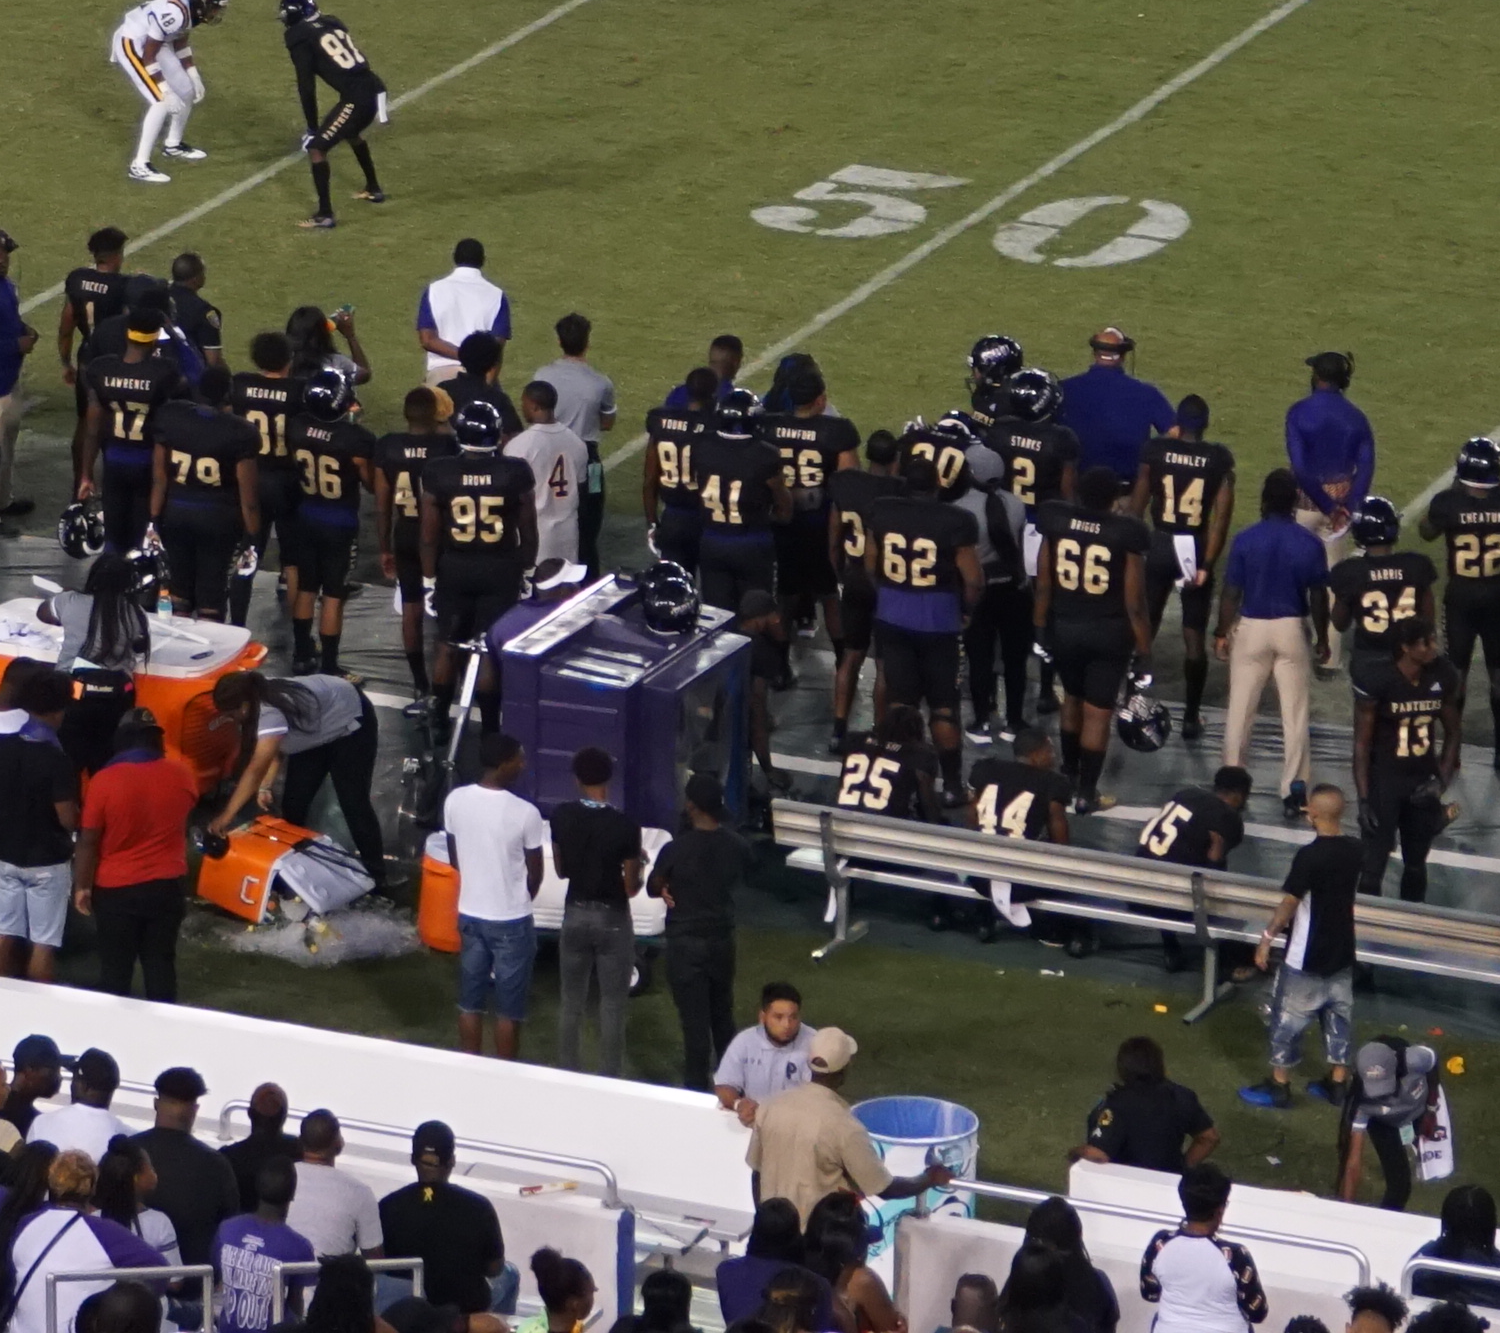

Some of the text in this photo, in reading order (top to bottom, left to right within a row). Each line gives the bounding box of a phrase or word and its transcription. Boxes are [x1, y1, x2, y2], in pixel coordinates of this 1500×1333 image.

[160, 12, 176, 30] 48
[322, 102, 355, 142] PANTHERS
[750, 163, 1192, 268] 50
[104, 375, 152, 392] LAWRENCE
[112, 400, 150, 442] 17
[661, 419, 688, 432] YOUNG
[776, 427, 817, 442] CRAWFORD
[1010, 434, 1042, 452] STARKS
[295, 450, 343, 501] 36
[404, 446, 427, 459] WADE
[462, 473, 493, 487] BROWN
[547, 453, 569, 499] 4
[1012, 456, 1036, 505] 2
[450, 496, 505, 543] 95
[701, 474, 743, 525] 41
[1162, 474, 1205, 527] 14
[883, 532, 938, 587] 62
[1055, 538, 1111, 595] 66
[1360, 586, 1417, 634] 34
[1390, 698, 1442, 715] PANTHERS
[1396, 717, 1431, 758] 13
[836, 753, 901, 813] 25
[975, 782, 1037, 839] 44
[1138, 800, 1194, 858] 15
